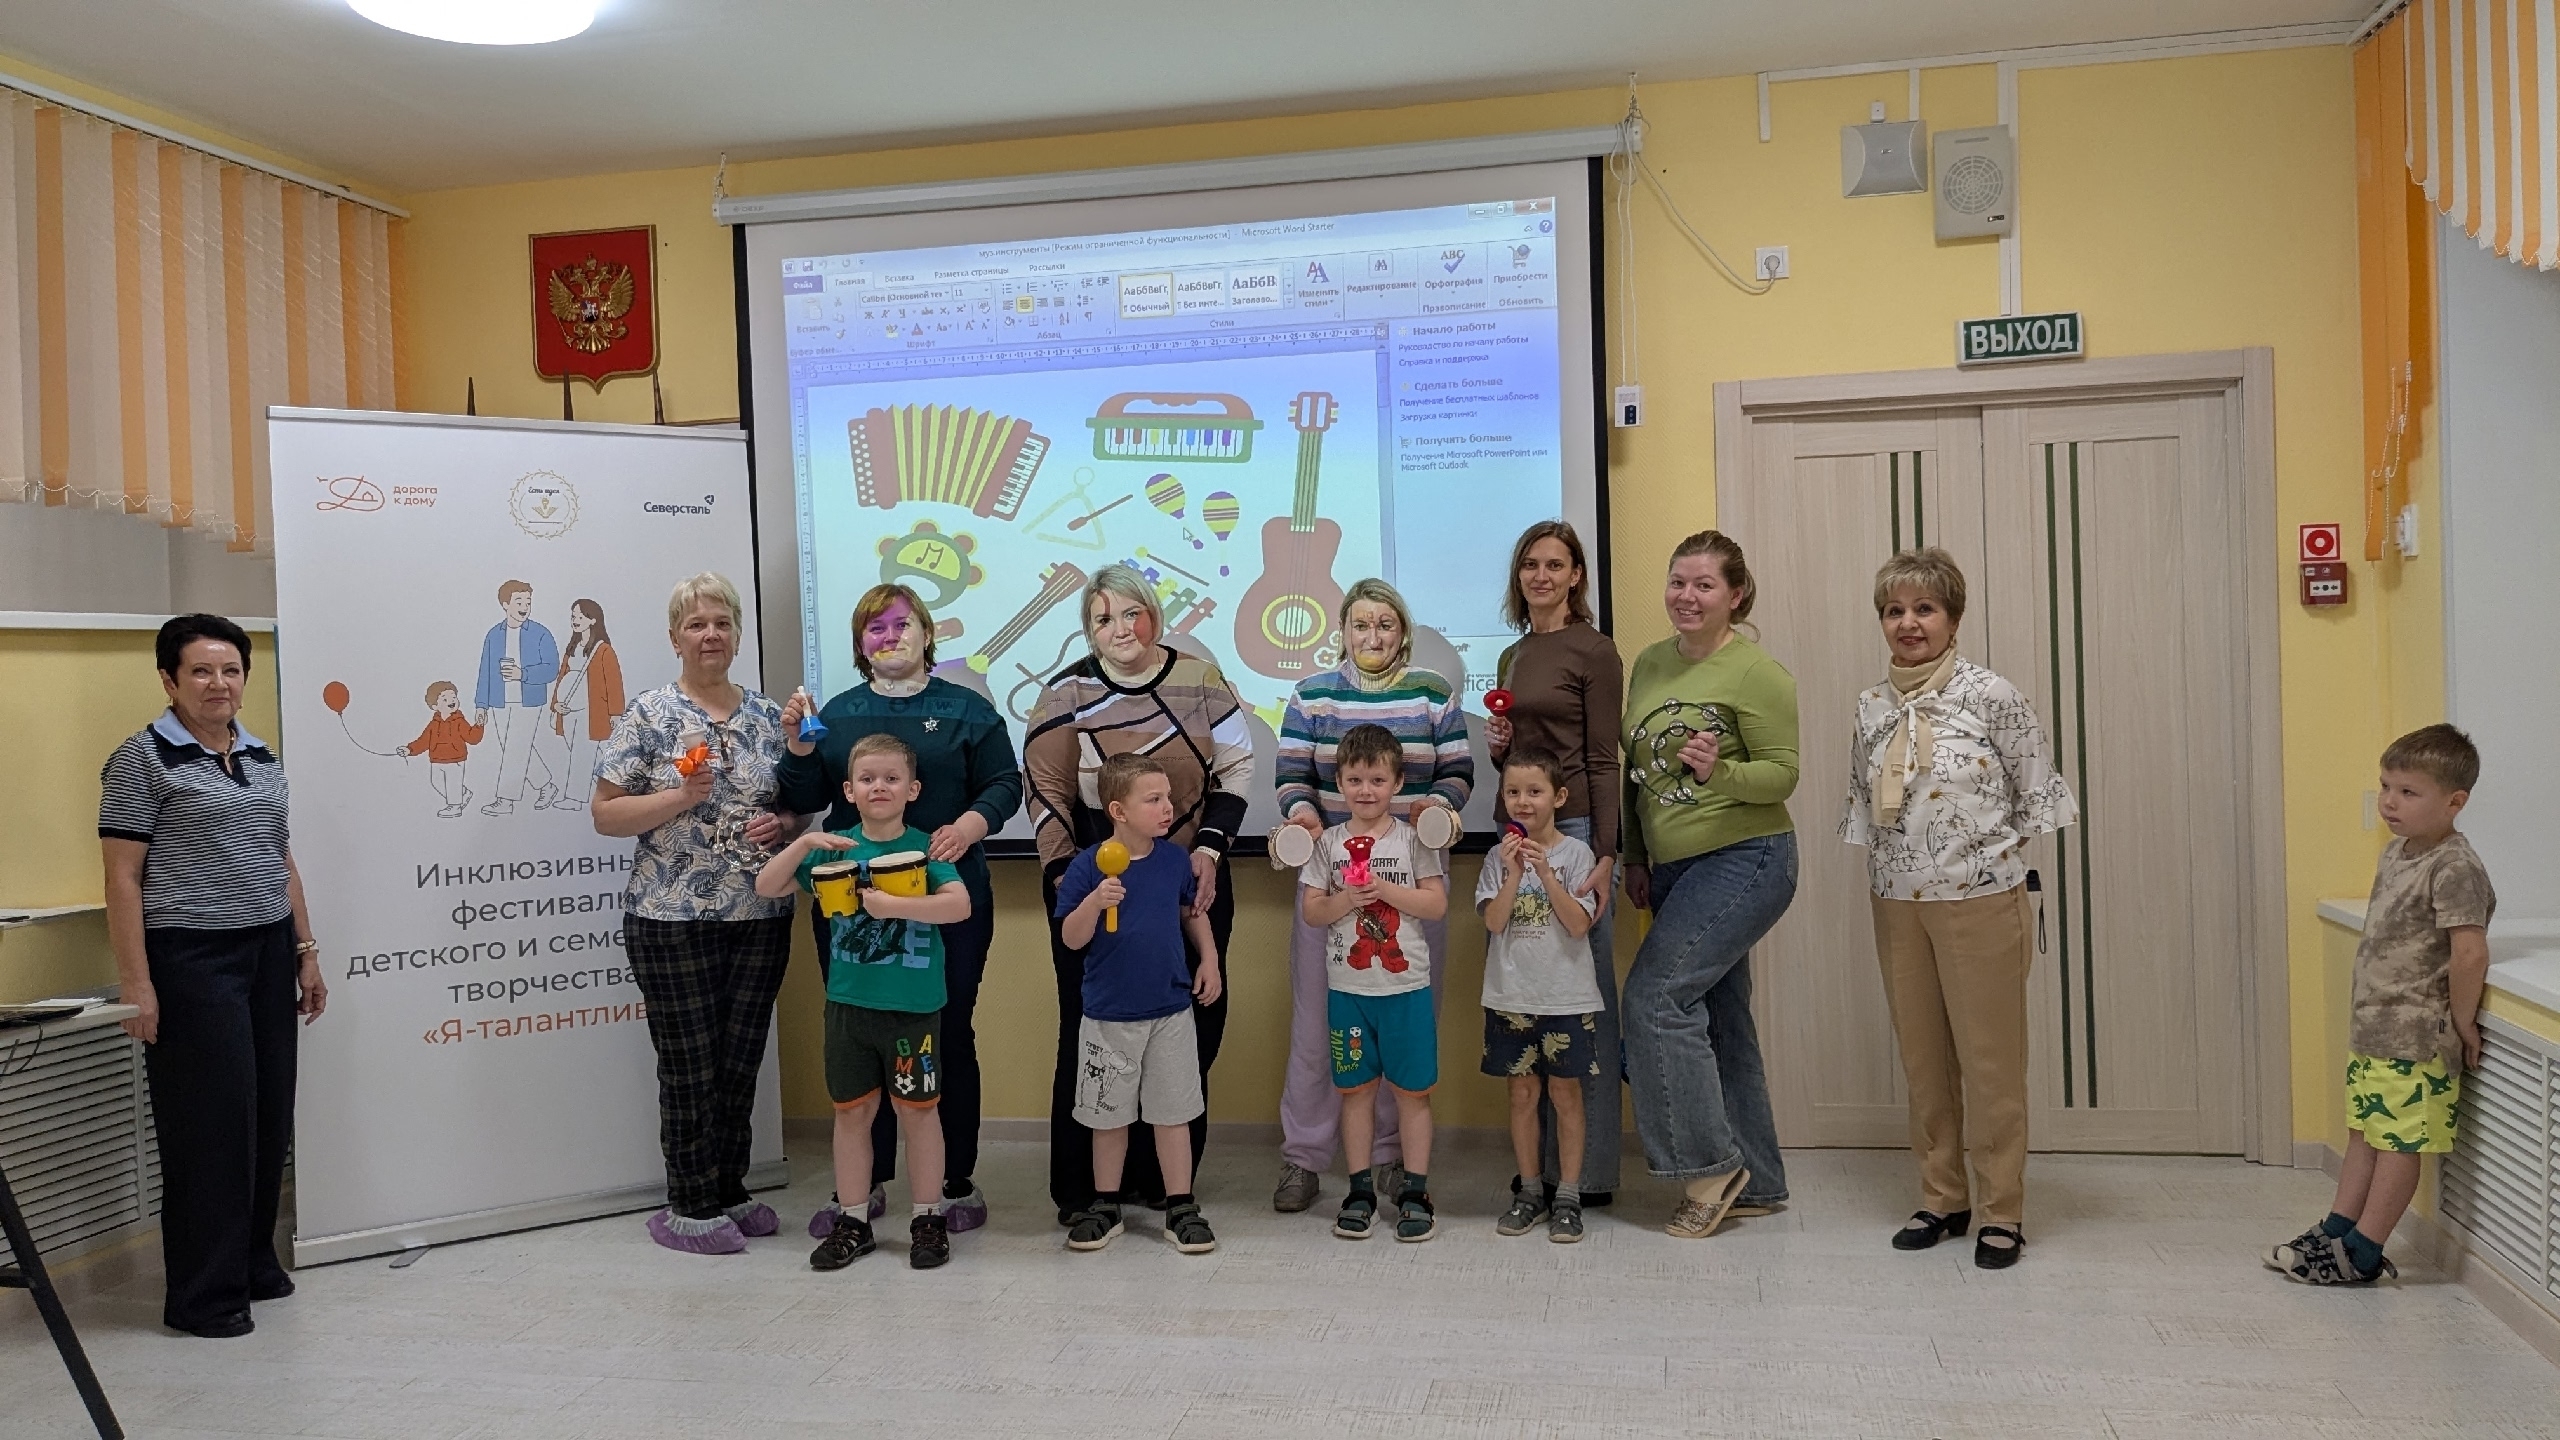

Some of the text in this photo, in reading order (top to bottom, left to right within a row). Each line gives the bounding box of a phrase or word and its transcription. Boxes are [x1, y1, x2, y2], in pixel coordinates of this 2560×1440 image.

[1085, 237, 1144, 251] ограниченной
[1241, 226, 1281, 237] Microsoft
[1282, 223, 1306, 235] Word
[1307, 222, 1335, 232] Starter
[1440, 249, 1465, 260] ABC
[934, 266, 1009, 280] Разметка страницы
[1029, 263, 1066, 272] Рассылки
[1424, 277, 1483, 290] Орфография
[1493, 272, 1548, 284] Приобрести
[1347, 281, 1417, 293] Редактирование
[1129, 303, 1170, 313] Обычный
[1422, 301, 1487, 314] Правописание
[1498, 297, 1544, 307] Обновить
[1209, 319, 1235, 328] Стили
[1413, 322, 1496, 337] Начало работы
[1037, 331, 1062, 341] Абзац
[1970, 318, 2073, 355] ВЫХОД
[1398, 341, 1451, 352] Руководство
[1465, 338, 1494, 348] началу
[1496, 335, 1529, 346] работы
[1398, 358, 1434, 368] Справка
[1442, 354, 1489, 366] поддержка
[1414, 376, 1503, 392] Сделать больше
[1399, 391, 1539, 408] Получение бесплатных шаблонов
[1400, 412, 1437, 423] Загрузка
[1415, 433, 1512, 447] Получить больше
[1400, 448, 1548, 463] Получение Microsoft PowerPoint или
[1401, 459, 1469, 472] Microsoft Outlook
[393, 486, 438, 496] дорога
[403, 497, 436, 508] дому
[643, 501, 711, 517] Северсталь
[1465, 674, 1496, 692] fice
[346, 929, 626, 979] детского и семе
[422, 1001, 648, 1045] «Я-талантлив
[1330, 1027, 1344, 1061] GIVE
